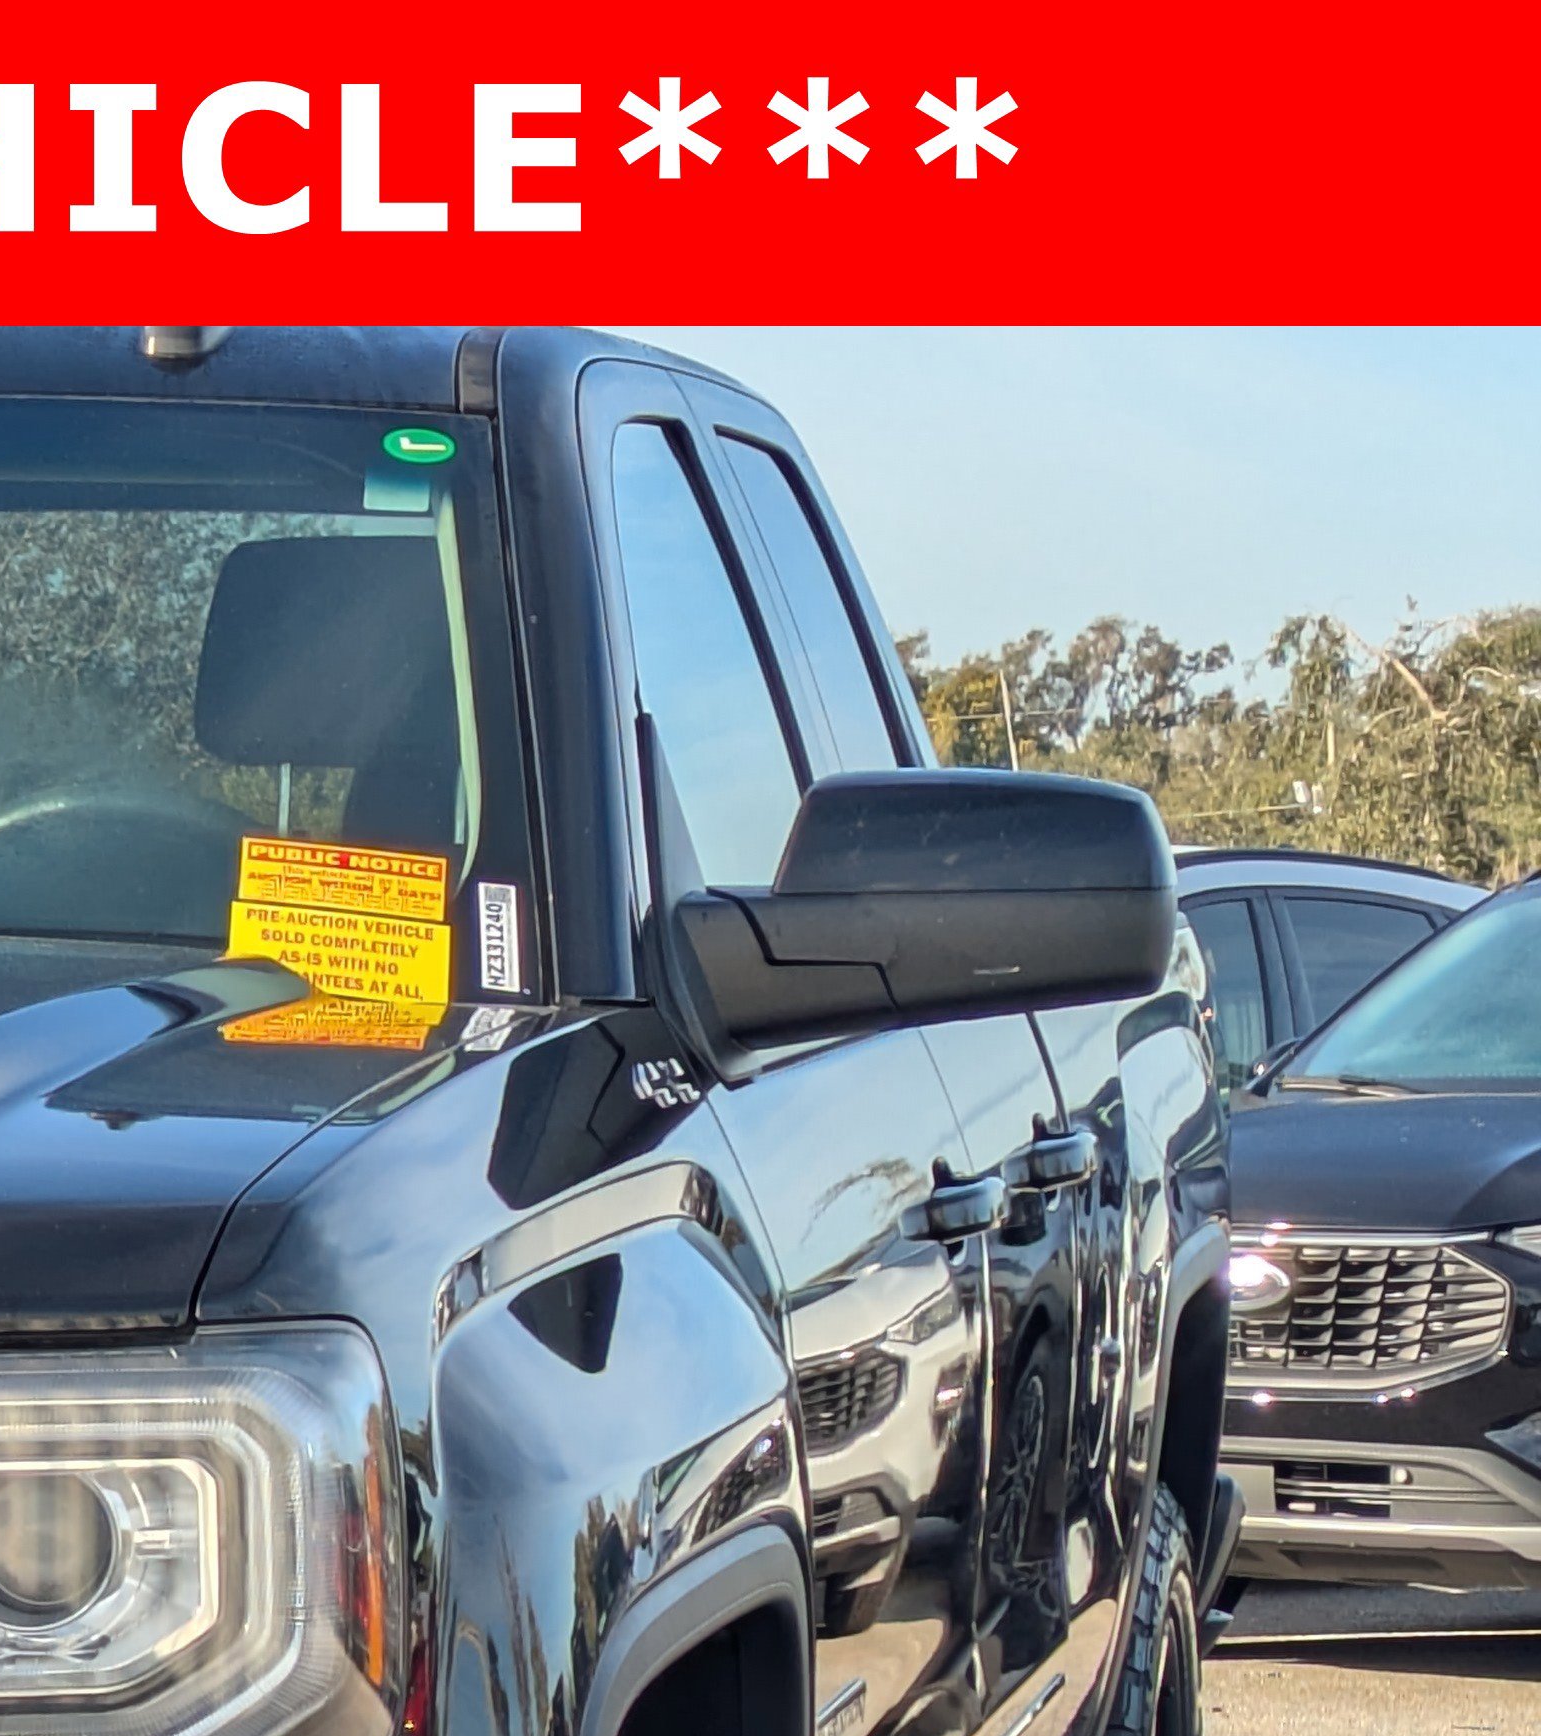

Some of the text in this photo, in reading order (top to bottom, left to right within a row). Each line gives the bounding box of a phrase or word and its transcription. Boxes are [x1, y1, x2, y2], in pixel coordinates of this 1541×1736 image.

[249, 844, 440, 878] PUBLIC NOTICE
[246, 908, 435, 941] PRE-AUCTION VEHICLE
[260, 928, 418, 958] SOLD COMPLETELY
[278, 949, 399, 976] AS-IS WITH NO
[369, 979, 389, 994] AT
